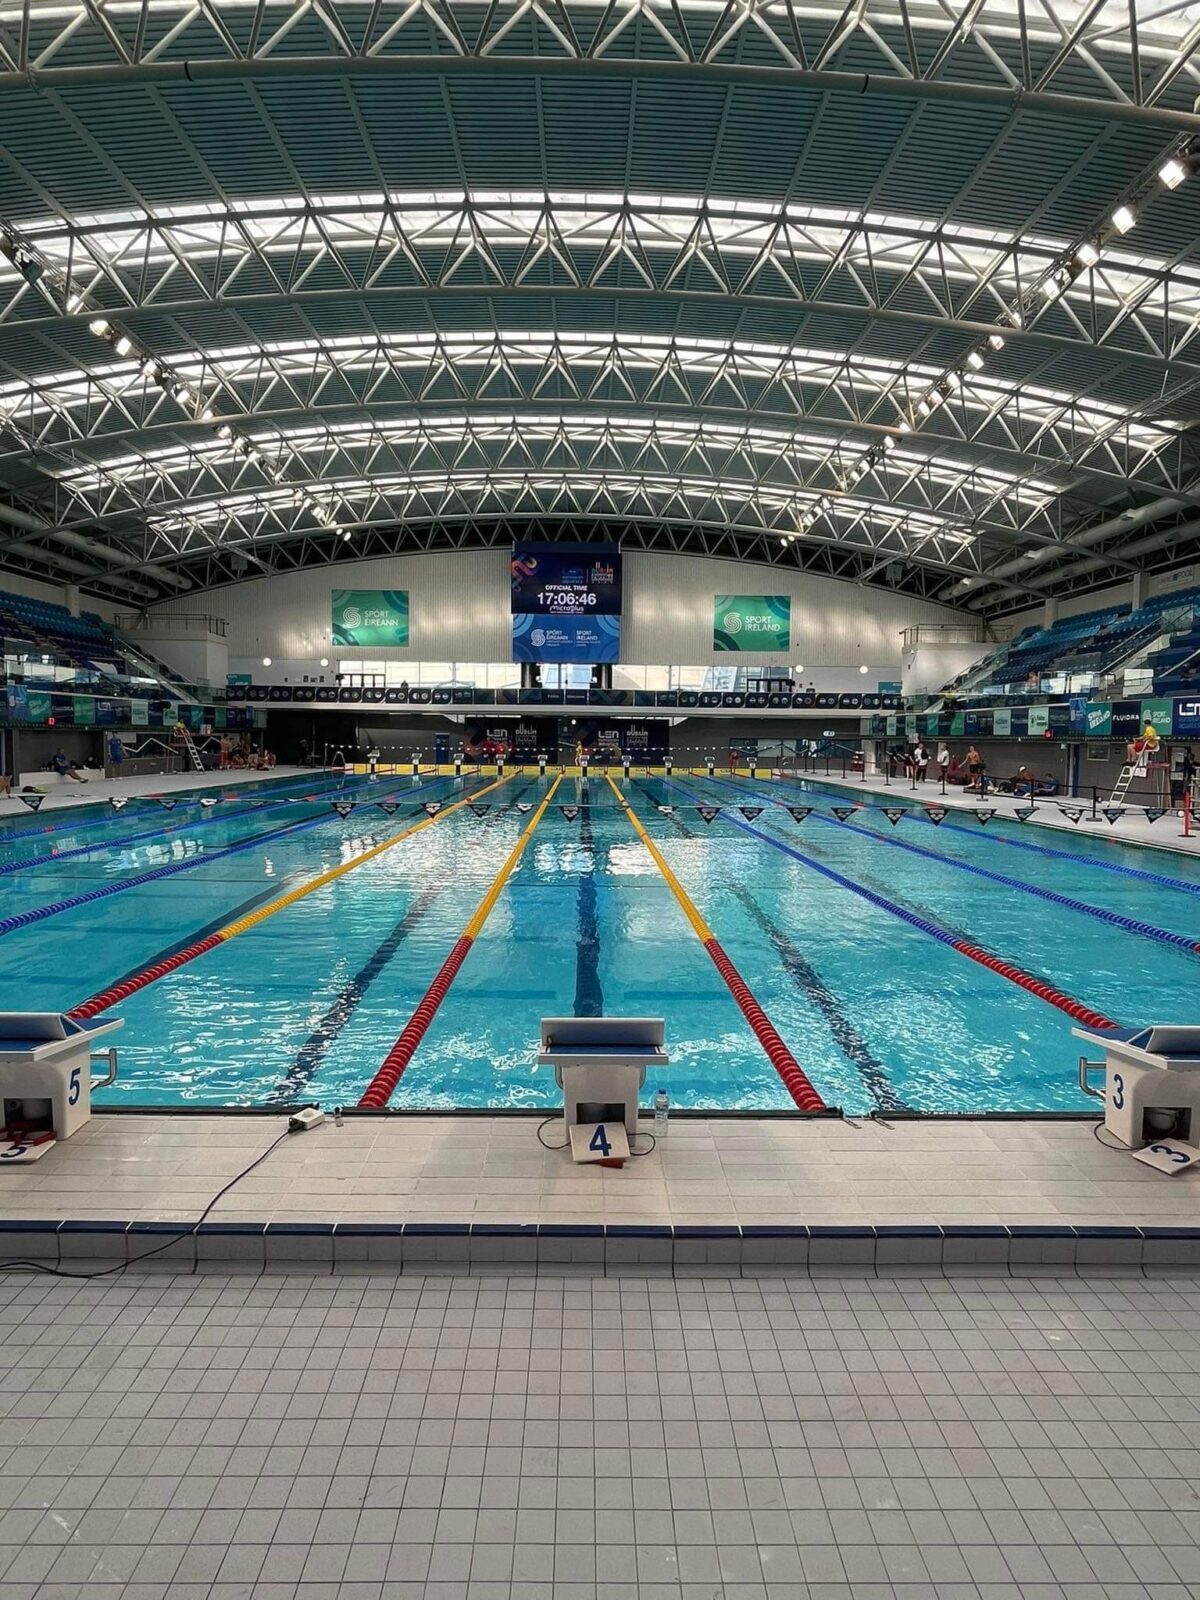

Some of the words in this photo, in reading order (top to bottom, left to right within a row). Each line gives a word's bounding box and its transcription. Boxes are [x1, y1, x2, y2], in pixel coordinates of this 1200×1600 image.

[537, 592, 597, 605] 17:06:46
[745, 615, 772, 624] SPORT
[745, 623, 781, 632] IRELAND
[69, 1066, 81, 1106] 5
[1112, 1073, 1124, 1110] 3
[589, 1124, 612, 1157] 4
[1150, 1145, 1191, 1163] 3
